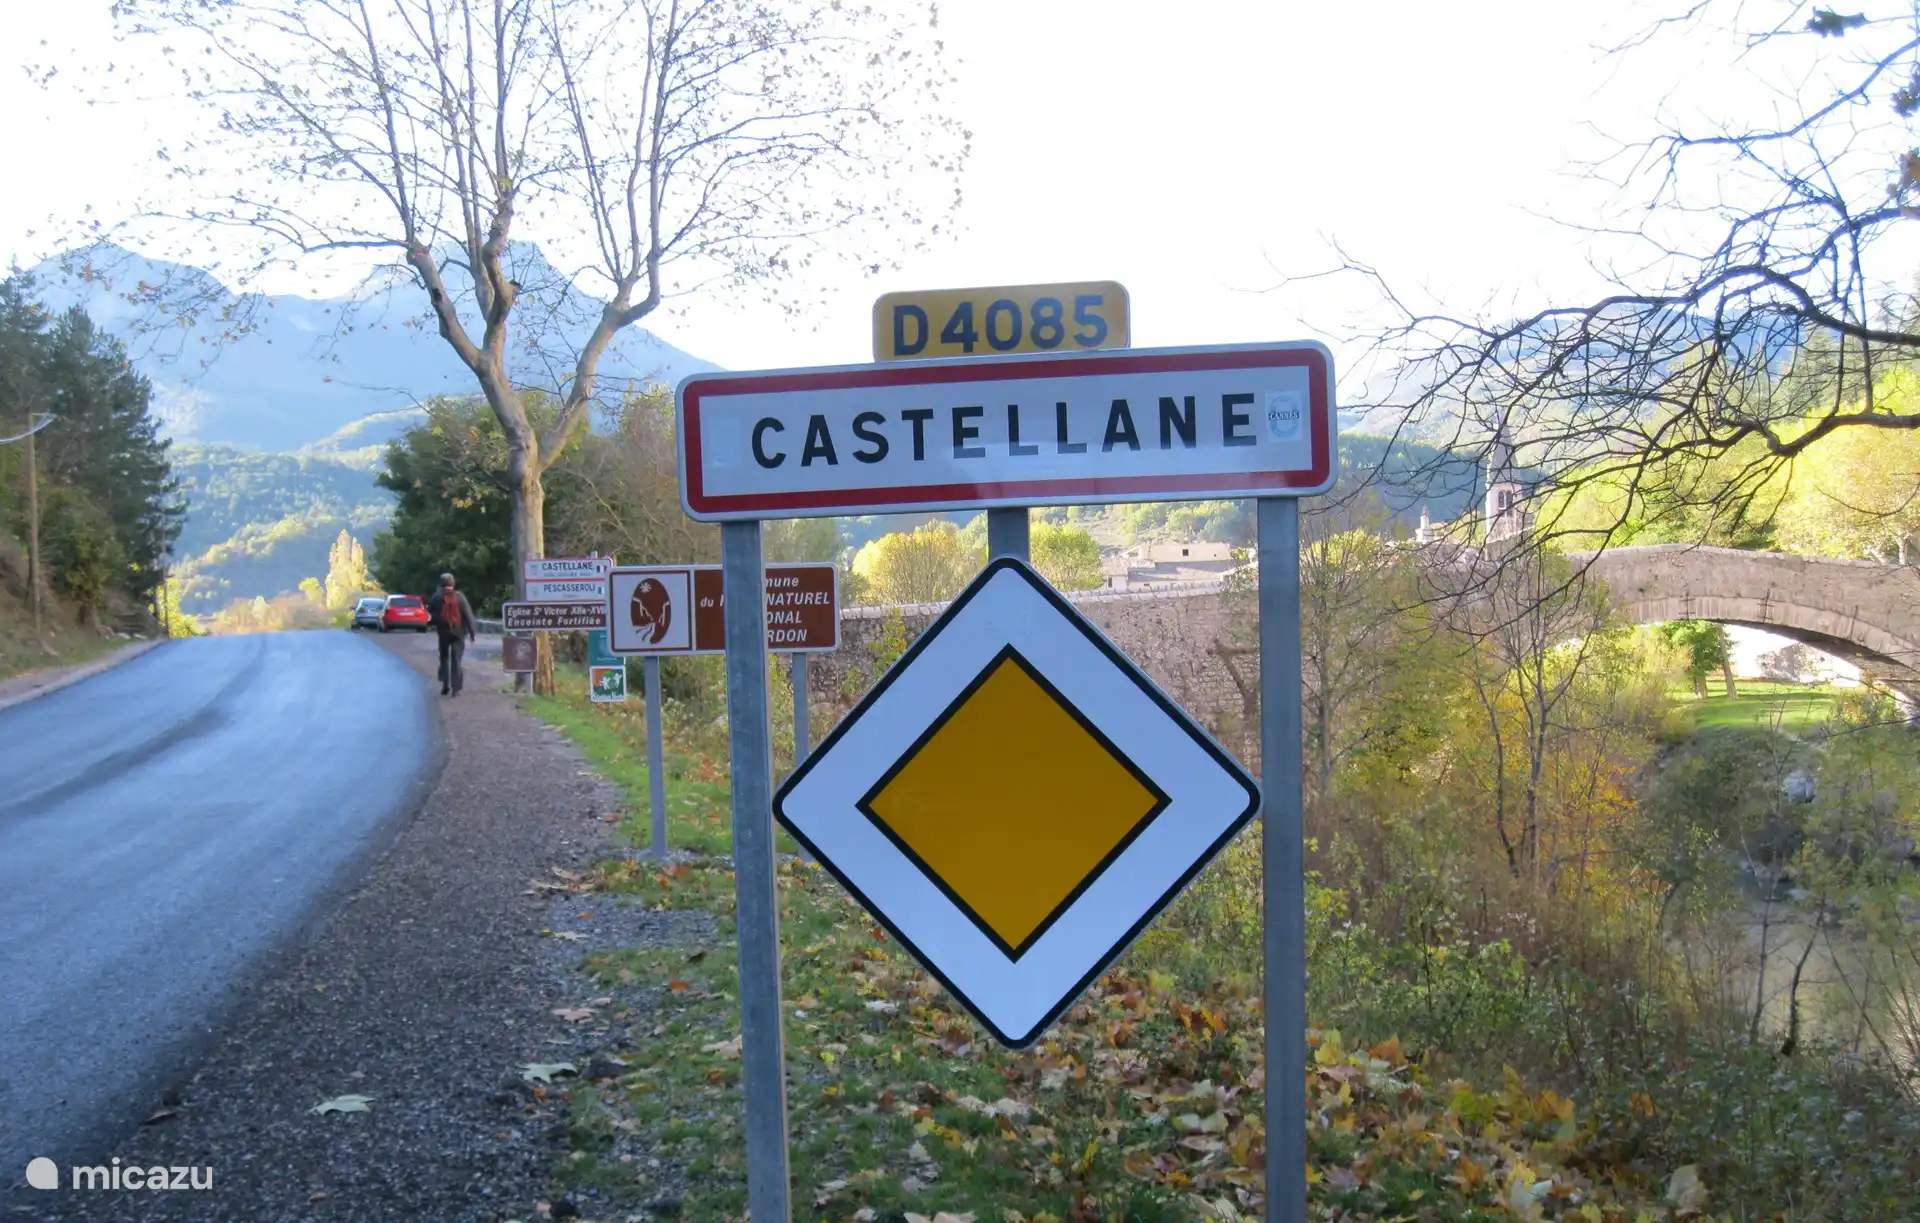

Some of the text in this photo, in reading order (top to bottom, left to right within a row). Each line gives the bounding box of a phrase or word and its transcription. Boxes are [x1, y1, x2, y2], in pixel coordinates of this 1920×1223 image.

[751, 392, 1257, 470] CASTELLANE
[542, 561, 593, 571] CASTELLANE
[700, 596, 714, 608] du
[765, 591, 831, 606] NATUREL
[767, 610, 803, 625] ONAL
[768, 628, 808, 643] RDON
